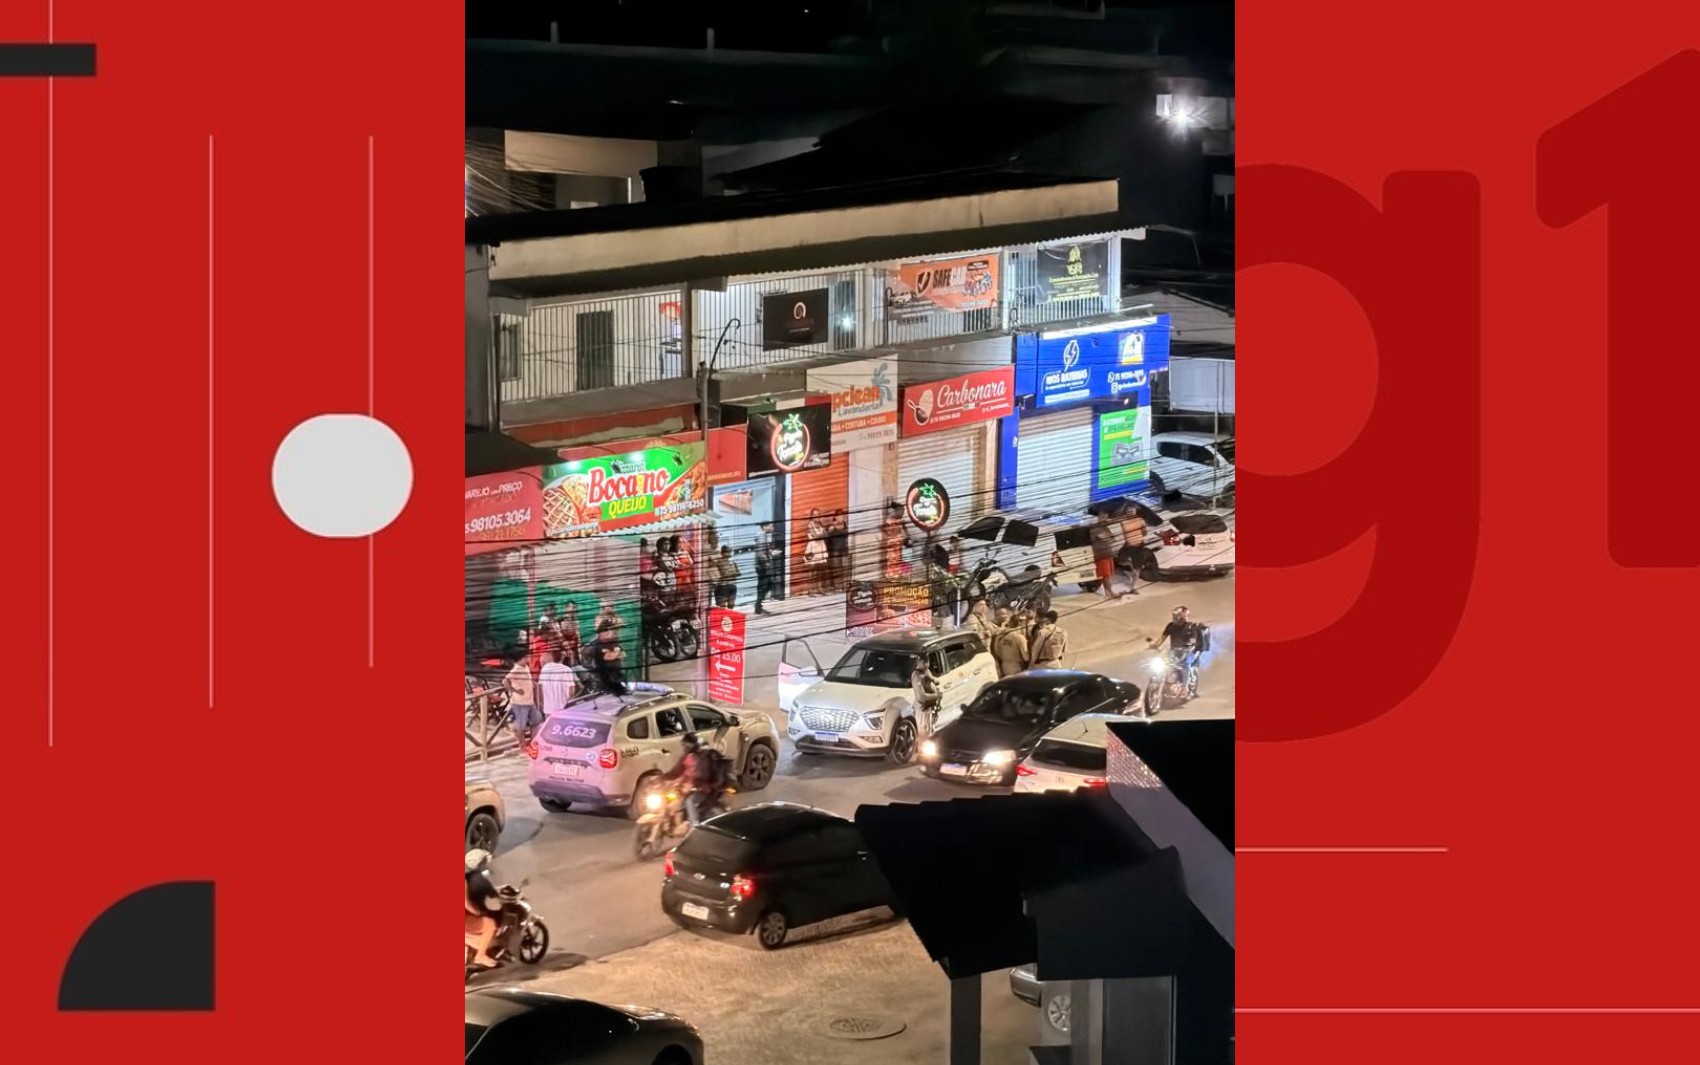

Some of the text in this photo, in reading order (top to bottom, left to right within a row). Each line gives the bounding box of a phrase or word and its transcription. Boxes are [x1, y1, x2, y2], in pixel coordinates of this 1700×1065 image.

[937, 379, 1006, 408] Carbonara
[608, 495, 647, 519] QUEIJO
[470, 506, 531, 533] 98105.3064
[883, 586, 929, 599] PROMOÇÃO
[551, 725, 597, 739] 9.6623
